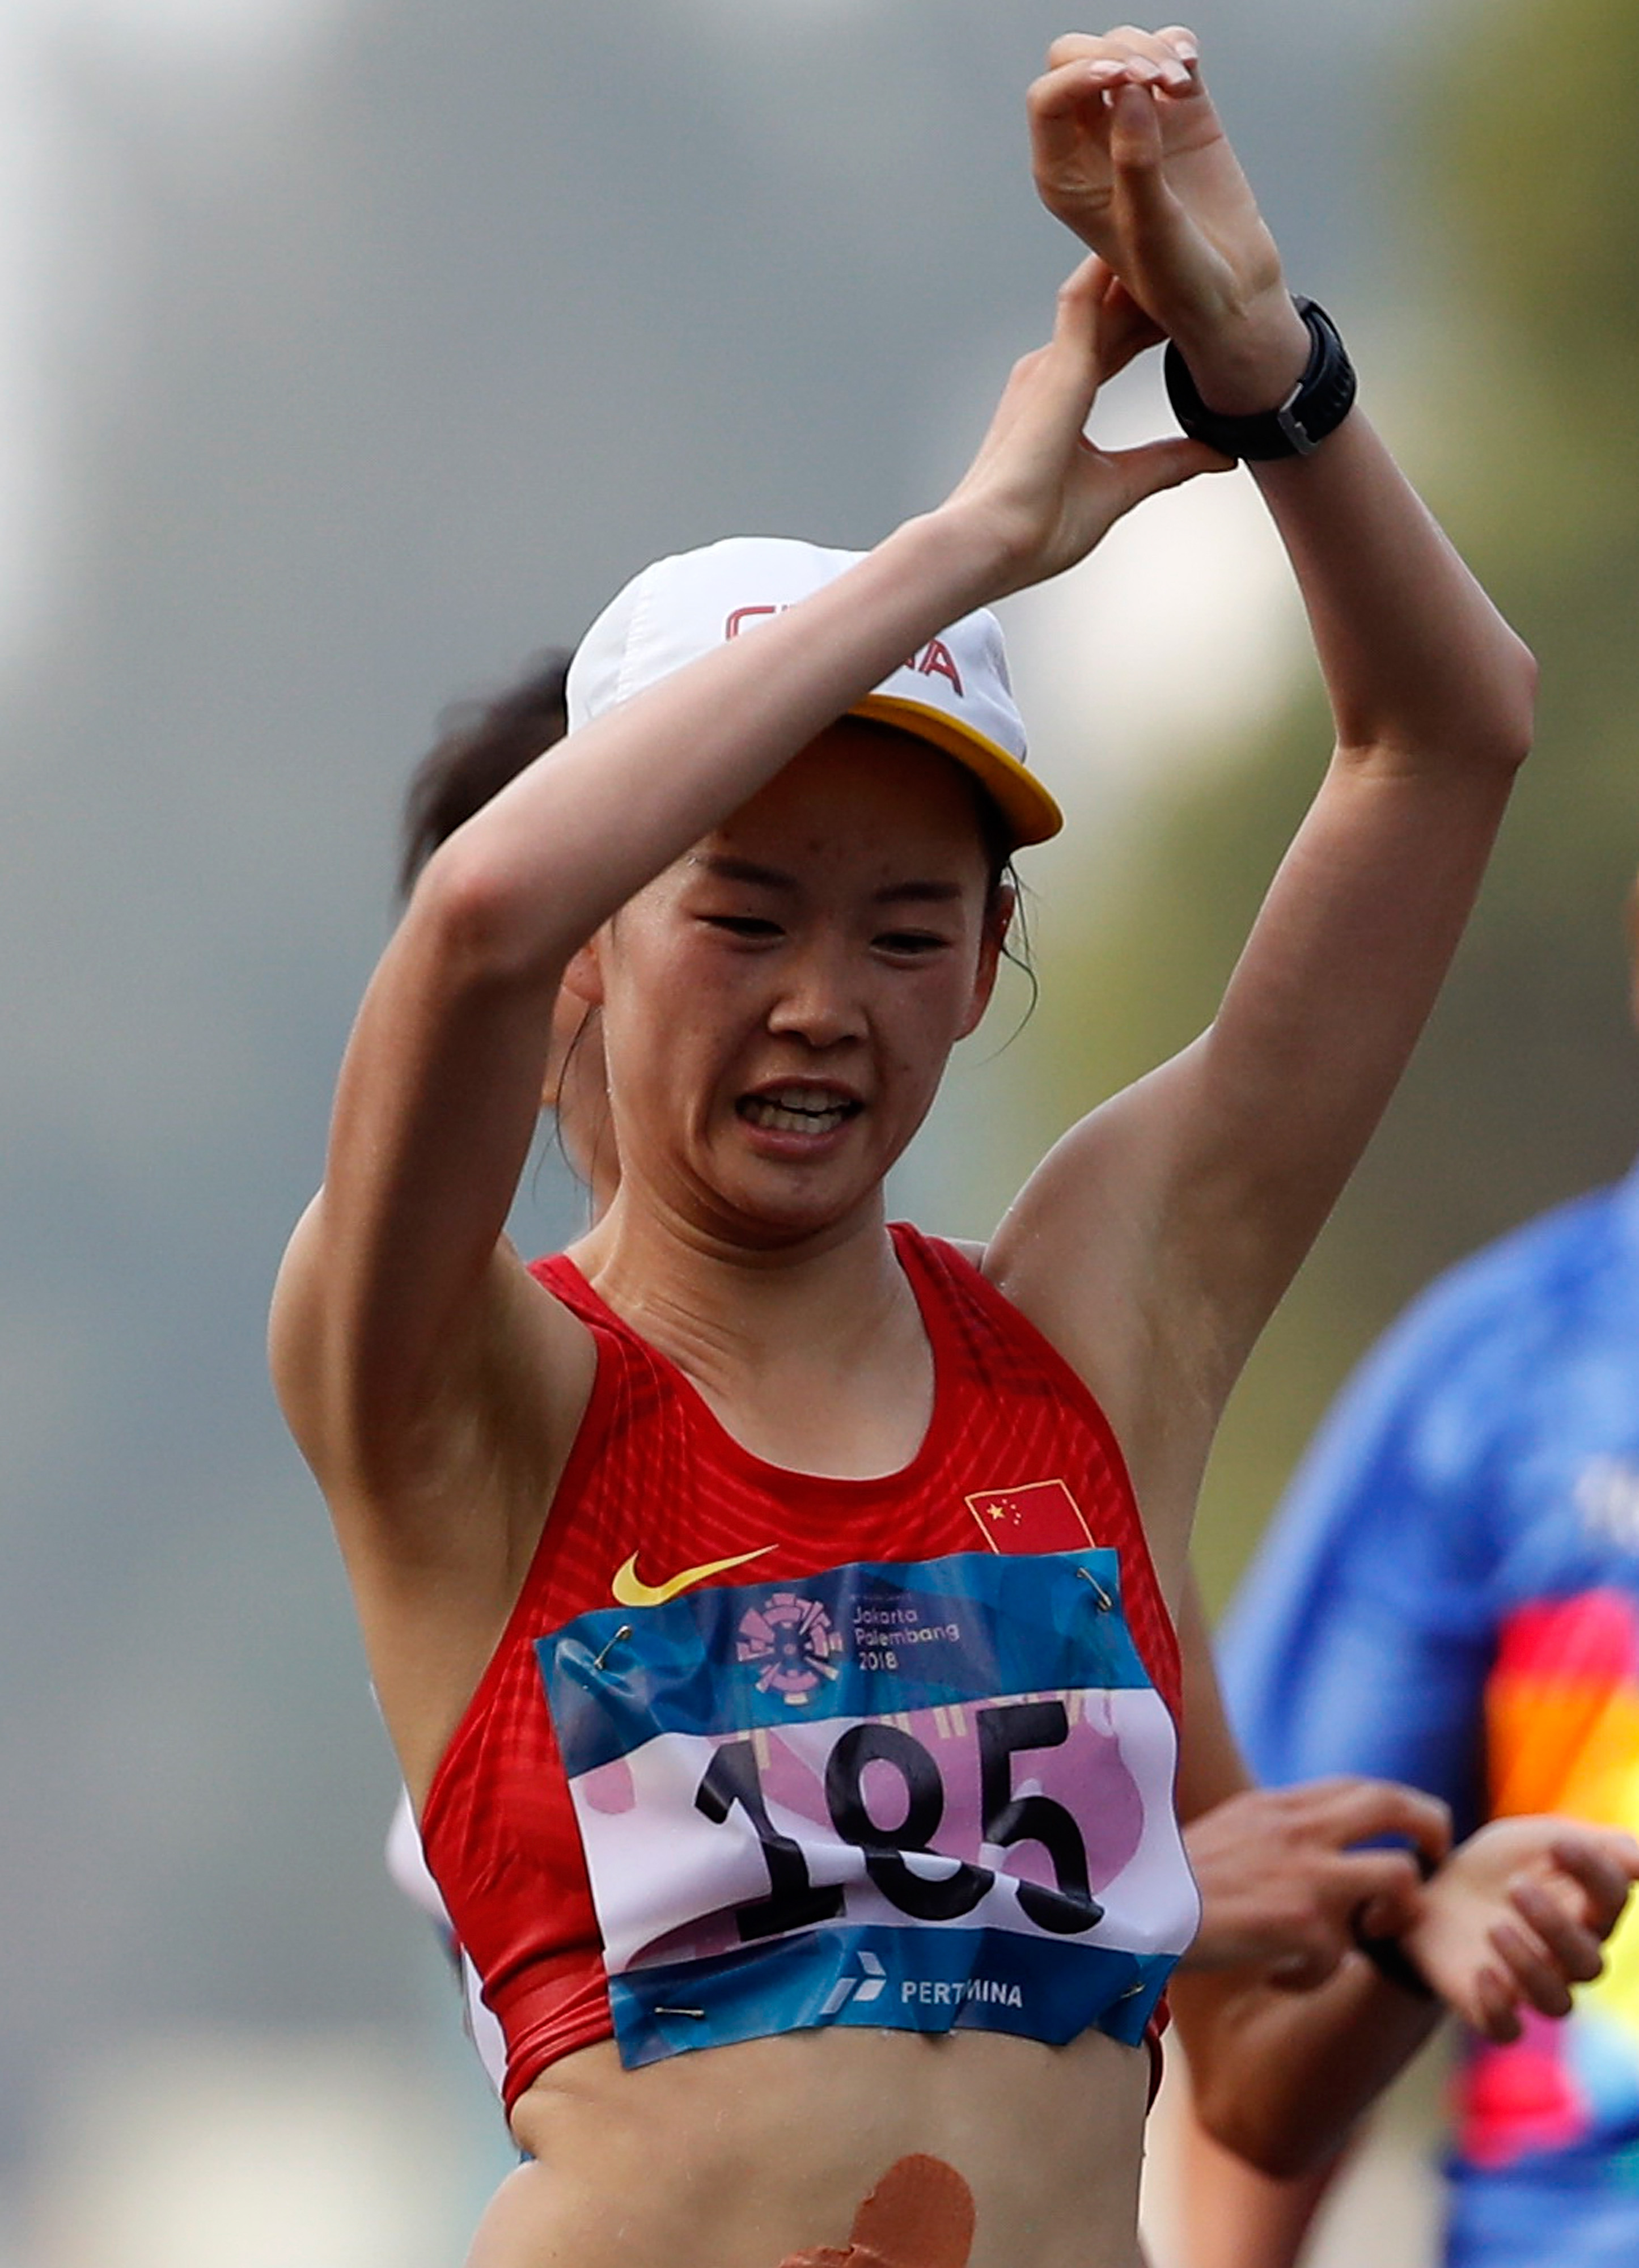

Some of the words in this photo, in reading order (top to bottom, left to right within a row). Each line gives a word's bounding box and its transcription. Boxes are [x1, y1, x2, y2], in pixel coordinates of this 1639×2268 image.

[853, 1606, 918, 1624] Jakarta
[854, 1623, 960, 1646] Palembang
[859, 1651, 899, 1670] 2018
[694, 1700, 1105, 1942] 185
[901, 1978, 1022, 2008] PERTMINA
